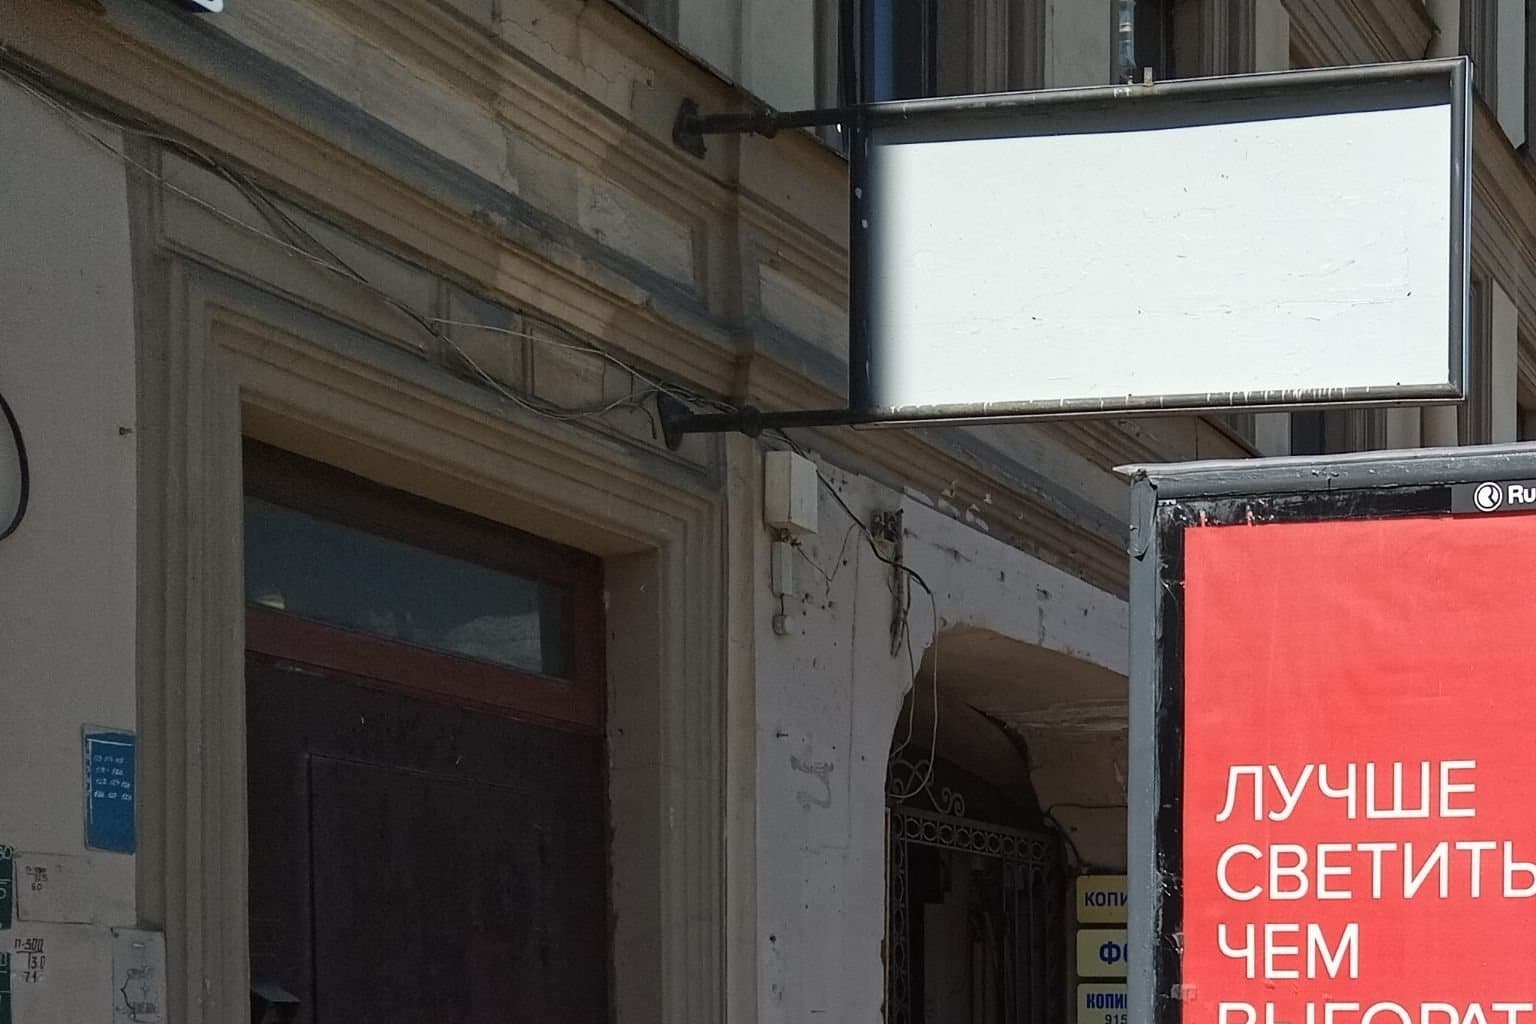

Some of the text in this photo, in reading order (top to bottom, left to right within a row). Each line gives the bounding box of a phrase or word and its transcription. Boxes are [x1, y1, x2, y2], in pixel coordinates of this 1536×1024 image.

[1216, 760, 1477, 822] ЛУЧШЕ
[1099, 940, 1128, 965] Ф
[1218, 923, 1360, 980] ЧЕМ
[1086, 992, 1128, 1009] КОПИ
